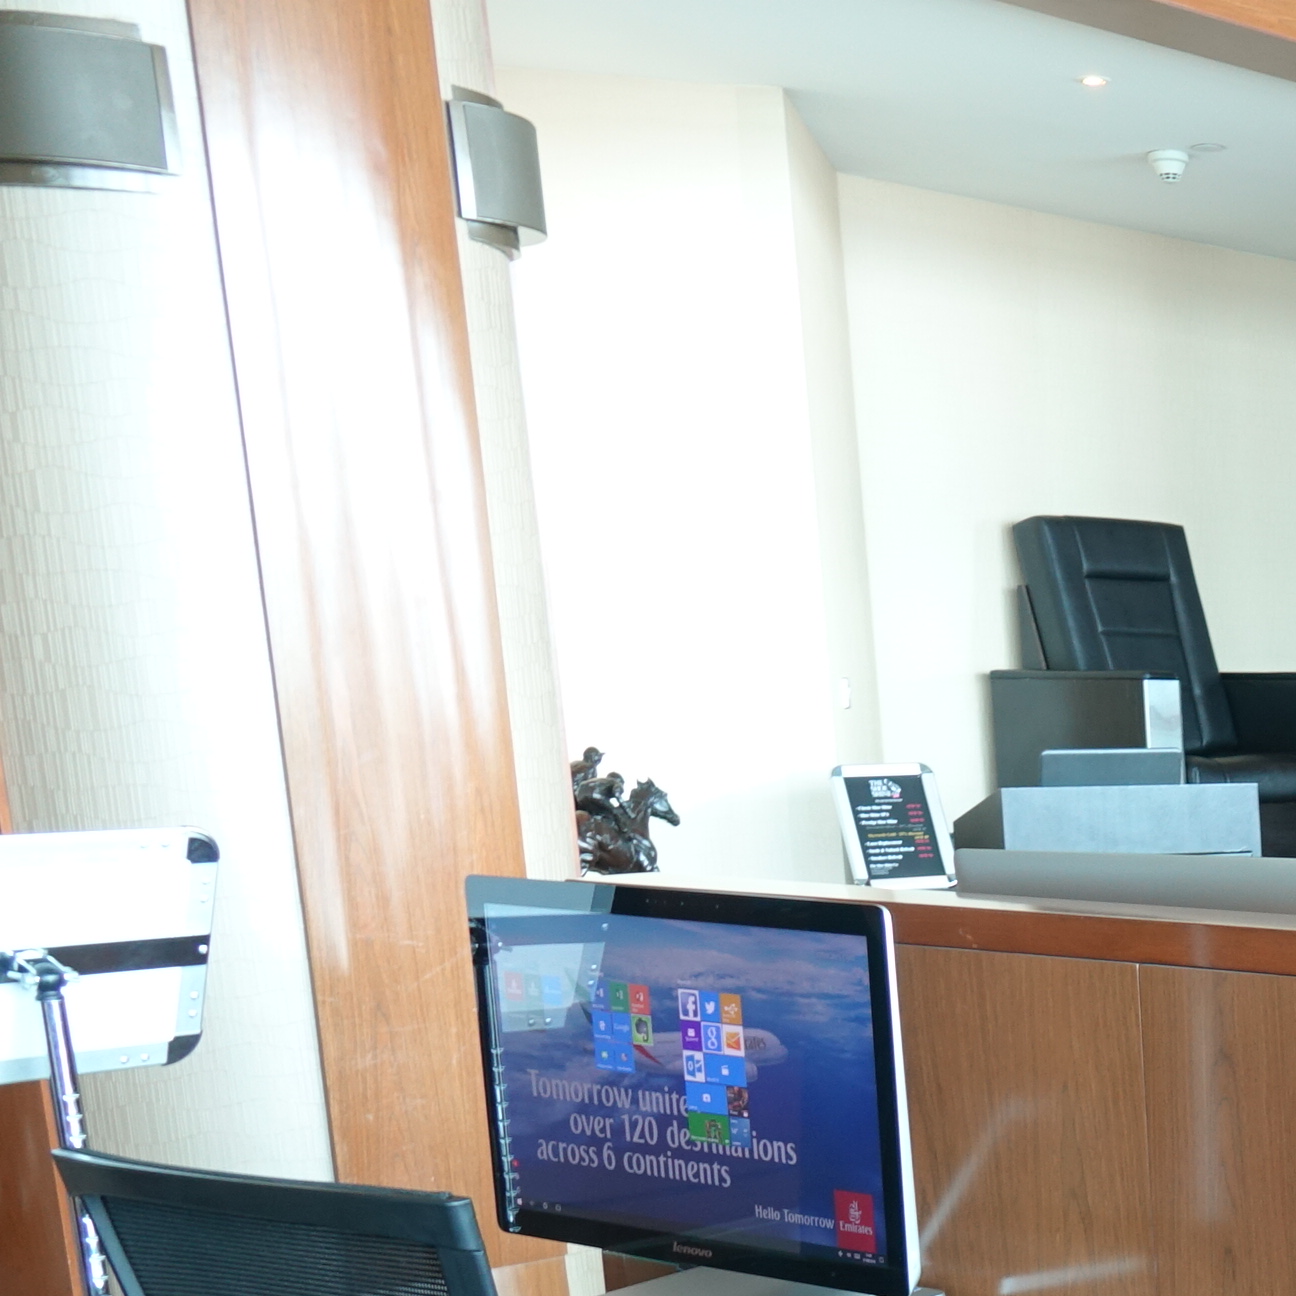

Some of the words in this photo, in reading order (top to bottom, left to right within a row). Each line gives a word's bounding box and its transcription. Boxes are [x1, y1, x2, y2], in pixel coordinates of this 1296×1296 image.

[527, 1068, 632, 1109] Tomorrow
[638, 1086, 688, 1117] unite
[570, 1111, 614, 1138] over
[621, 1113, 658, 1146] 120
[537, 1139, 599, 1169] across
[602, 1141, 616, 1170] 6
[623, 1151, 731, 1188] continents
[755, 1204, 781, 1221] Hello
[783, 1208, 835, 1230] Tomorrow
[839, 1220, 873, 1236] Emirates
[672, 1241, 713, 1259] lenovo
